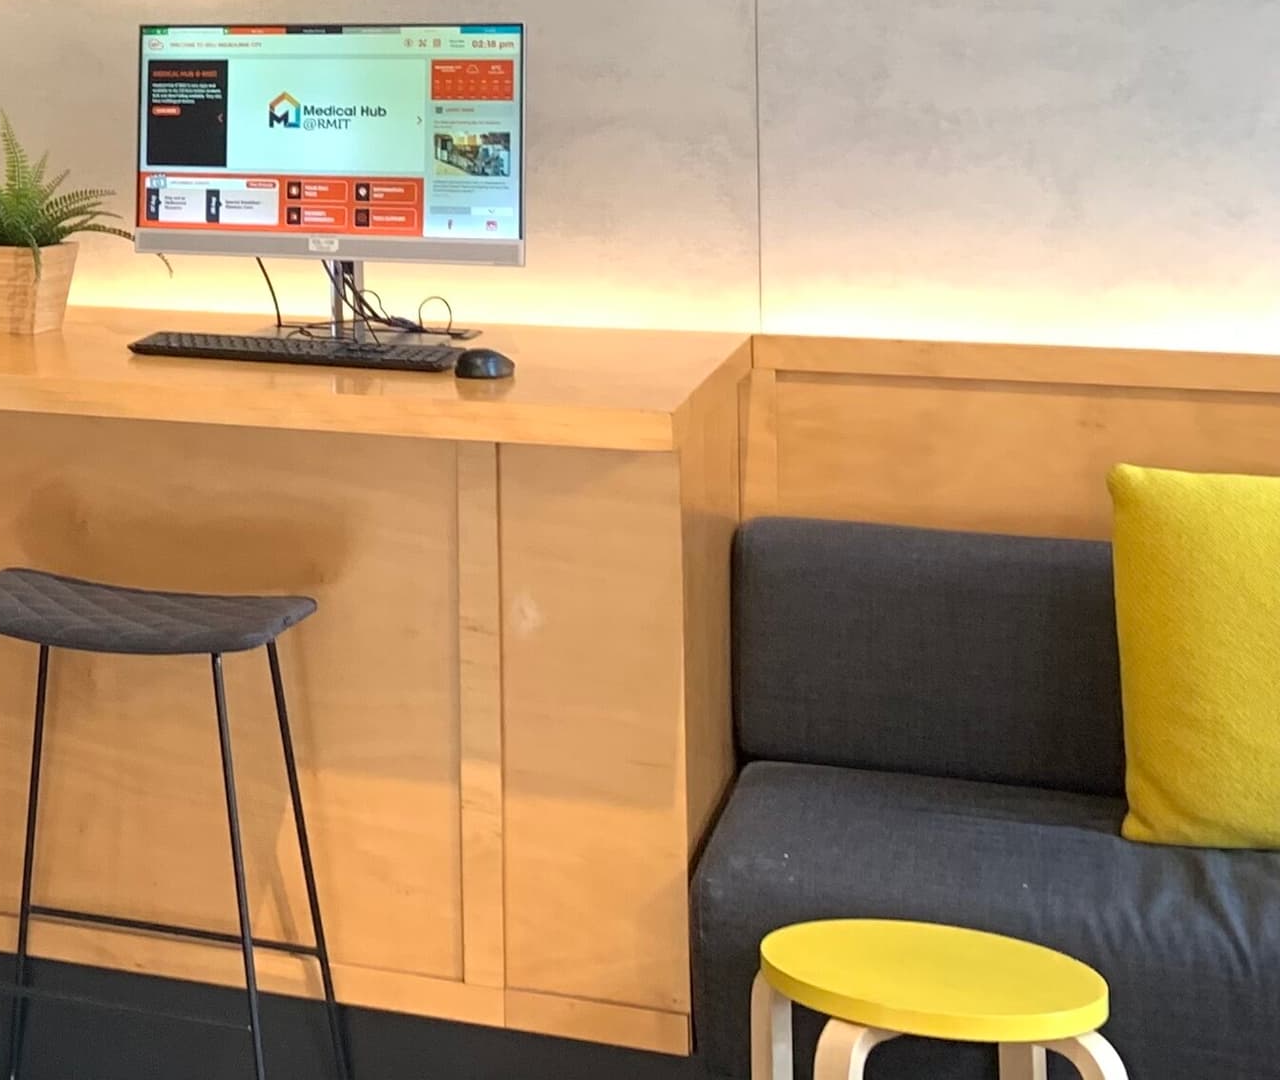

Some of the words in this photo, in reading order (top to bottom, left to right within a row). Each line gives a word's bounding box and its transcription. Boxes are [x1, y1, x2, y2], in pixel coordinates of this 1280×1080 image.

[499, 41, 515, 50] pm
[303, 105, 357, 117] Medical
[360, 105, 387, 117] Hub
[303, 118, 351, 131] @RMIT
